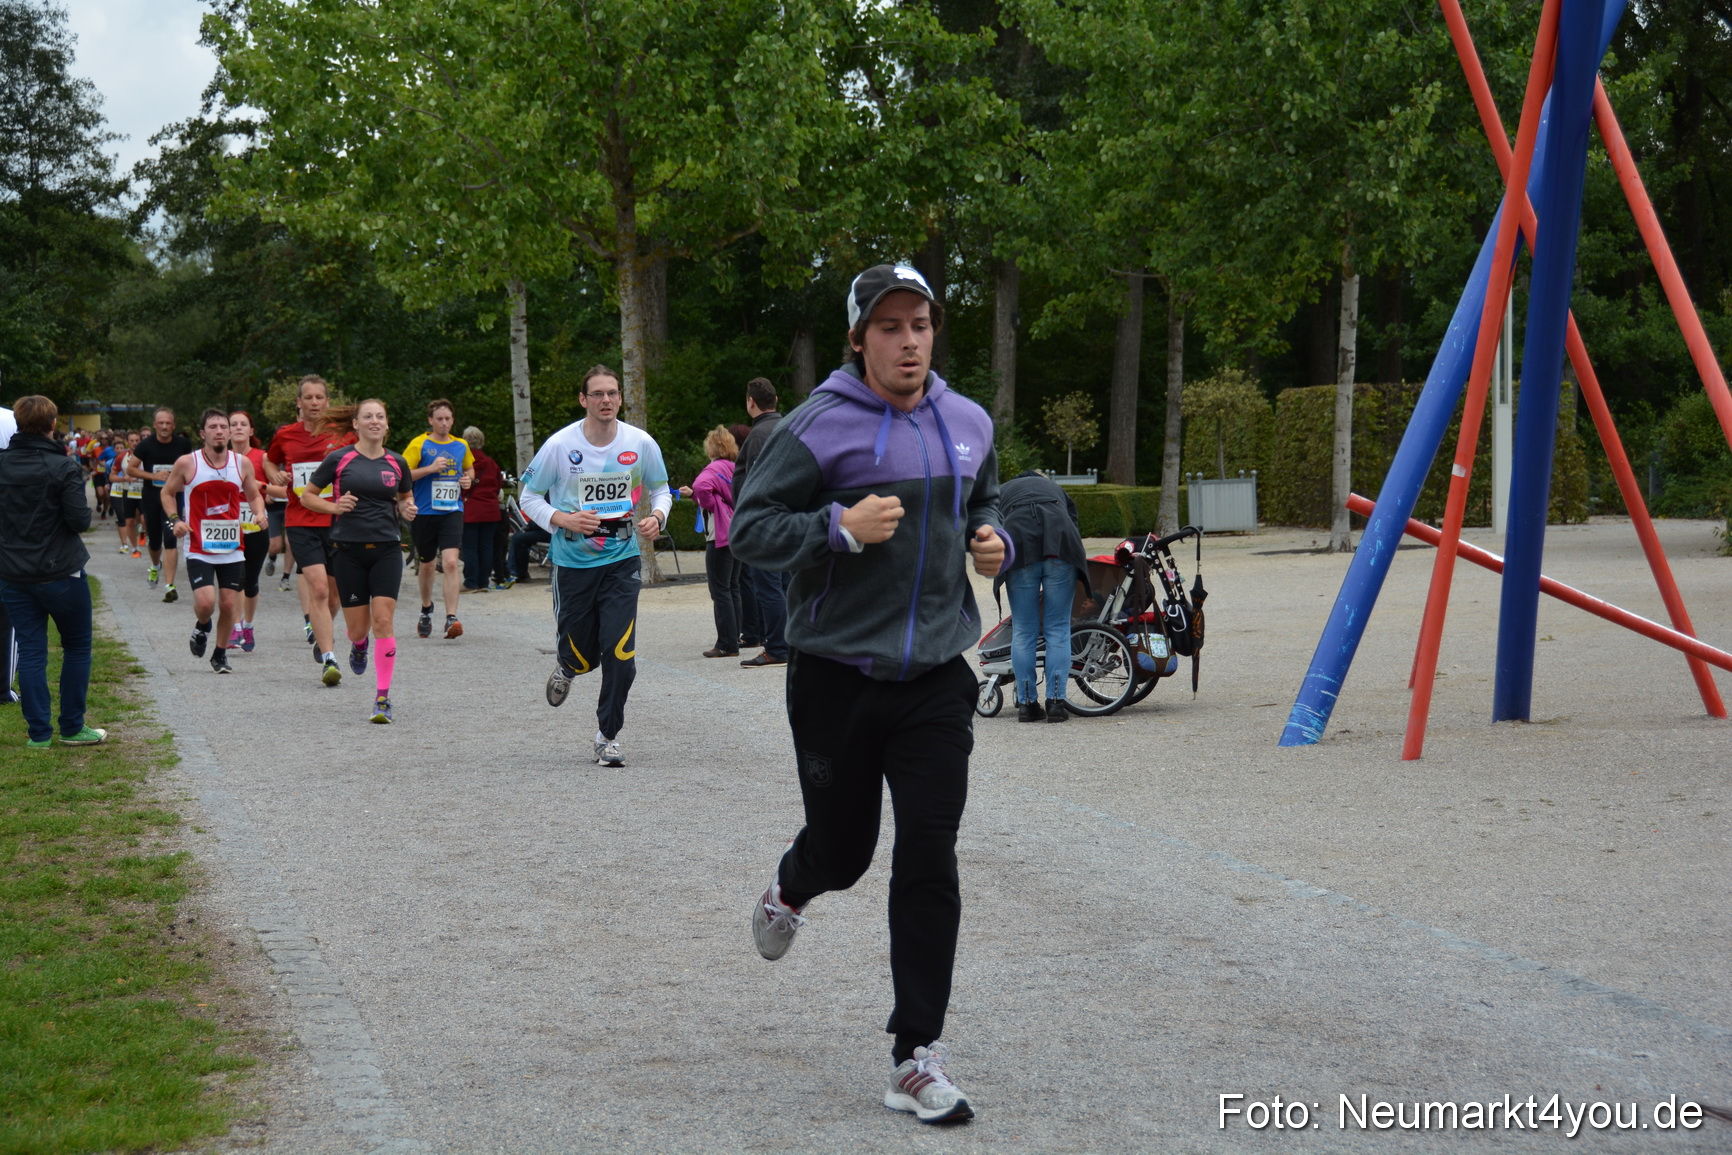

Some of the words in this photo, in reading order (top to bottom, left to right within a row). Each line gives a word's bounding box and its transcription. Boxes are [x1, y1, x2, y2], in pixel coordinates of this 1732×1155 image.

[435, 488, 458, 500] 2701
[584, 482, 628, 502] 2692
[205, 527, 237, 541] 2200
